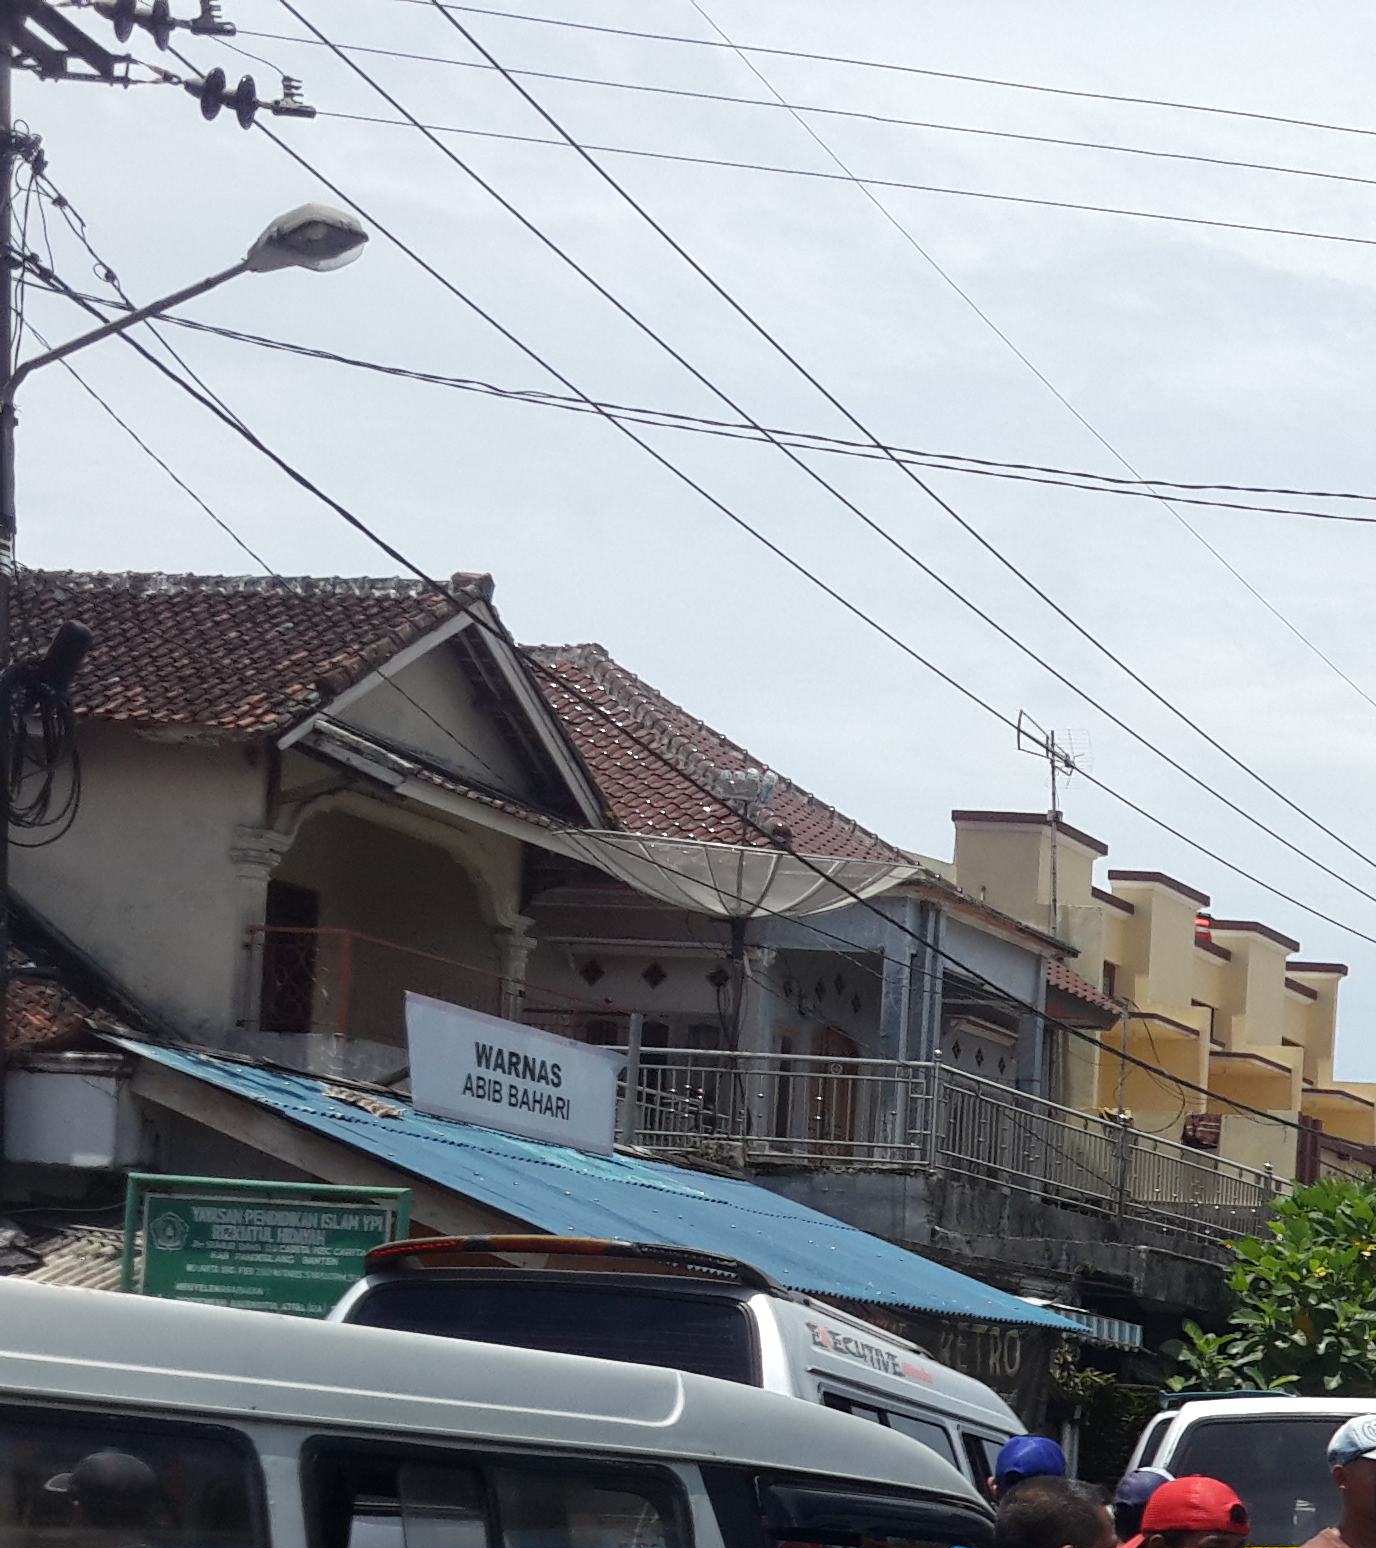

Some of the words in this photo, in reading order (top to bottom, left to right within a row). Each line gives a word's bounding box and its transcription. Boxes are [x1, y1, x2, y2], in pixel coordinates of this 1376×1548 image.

[475, 1041, 562, 1088] WARNAS
[463, 1073, 502, 1103] ABIB
[508, 1084, 570, 1120] BAHARI
